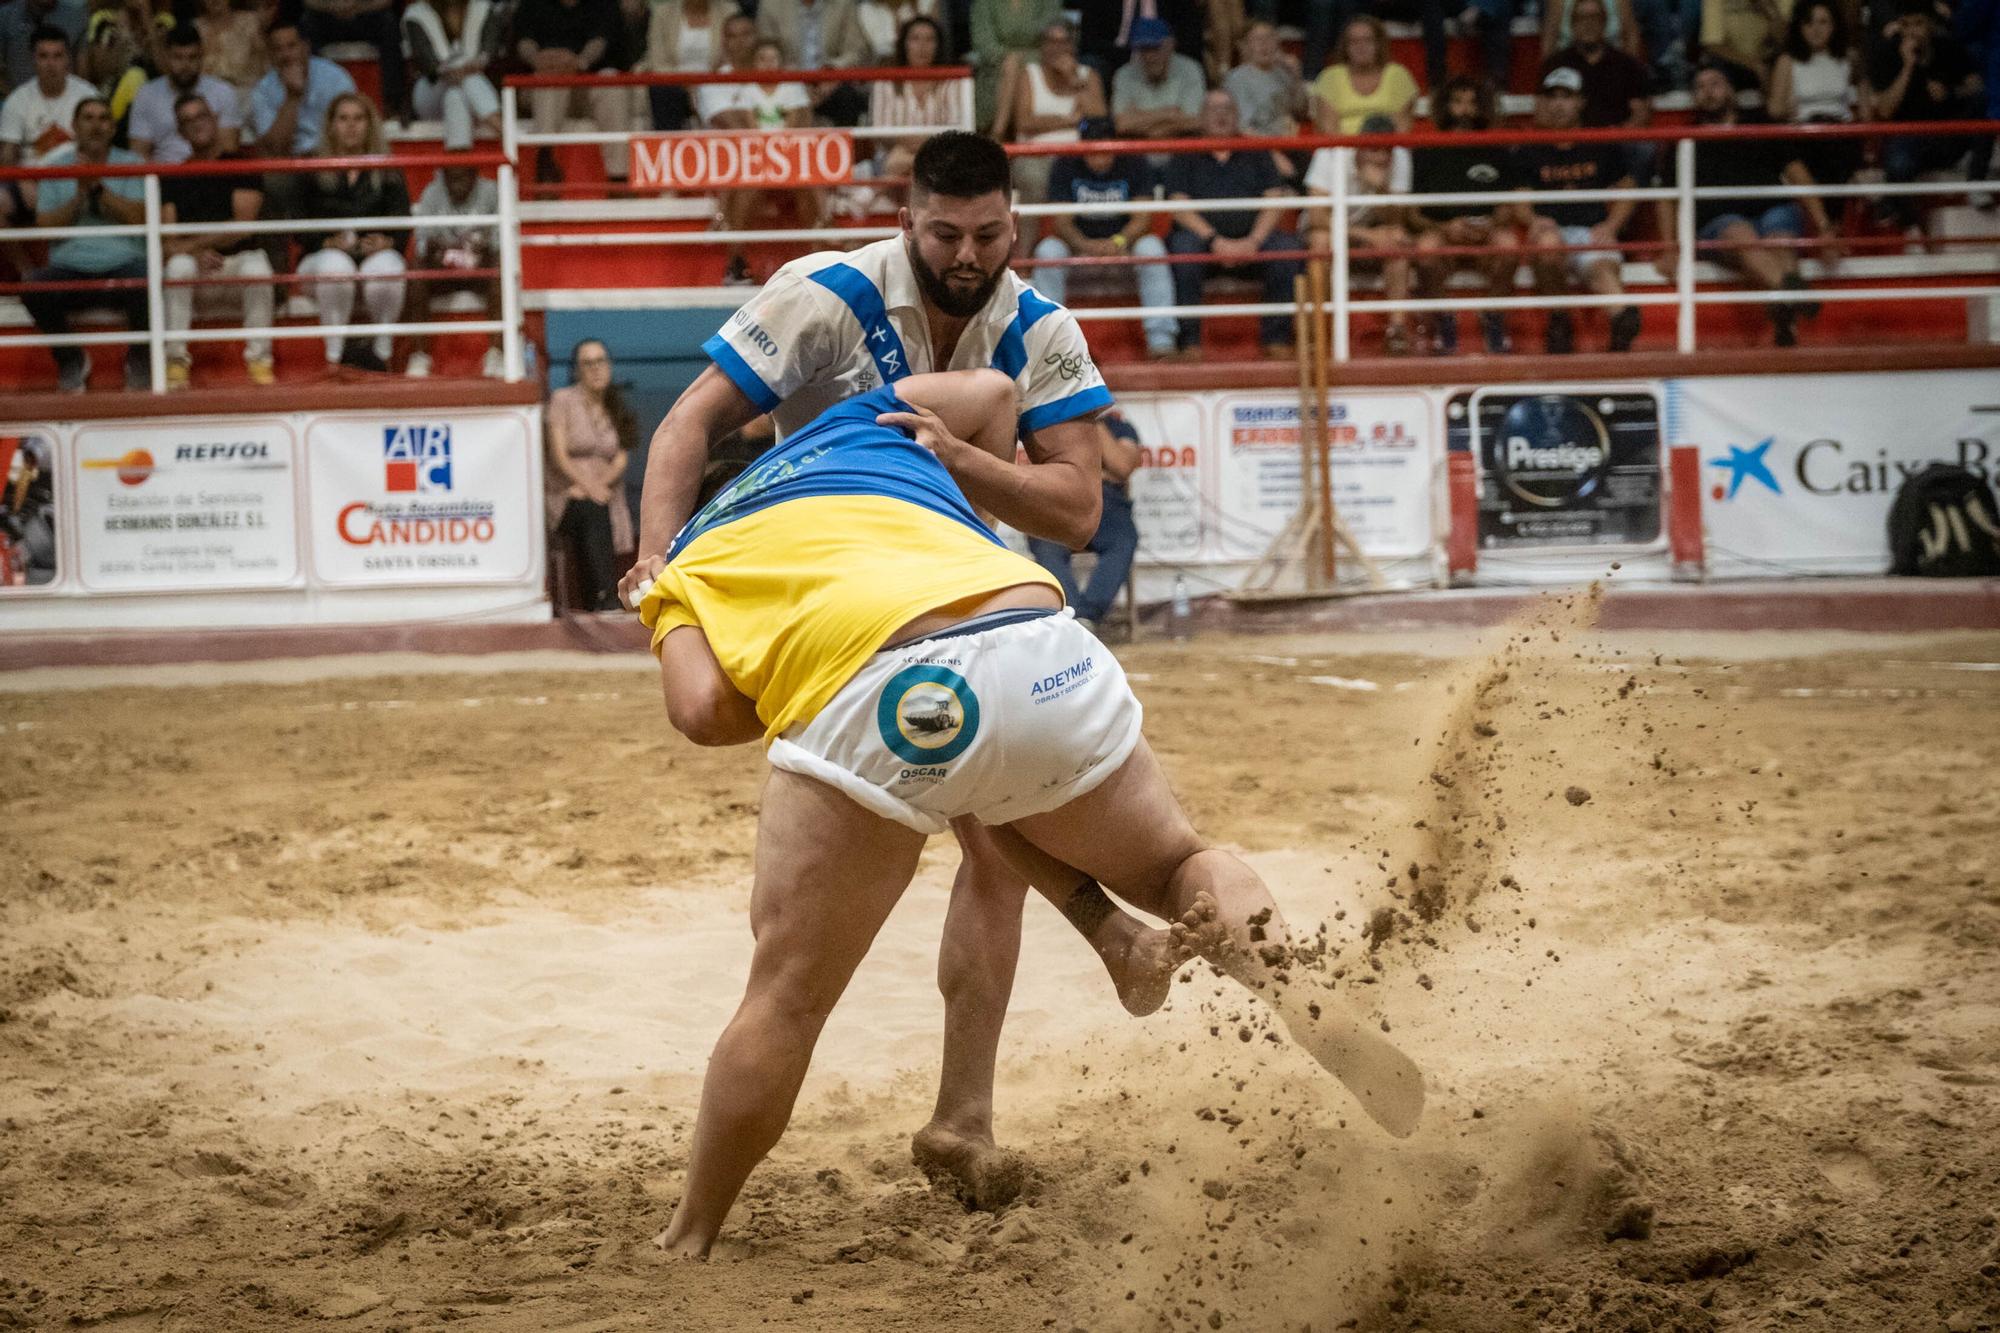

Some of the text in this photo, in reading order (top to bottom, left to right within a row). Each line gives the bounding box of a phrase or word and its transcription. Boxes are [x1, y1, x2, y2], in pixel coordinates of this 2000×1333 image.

[634, 133, 850, 187] MODESTO
[175, 442, 270, 460] REPSOL
[1507, 435, 1602, 474] Prestige
[336, 501, 495, 545] CANDIDO
[1030, 656, 1093, 697] ADEYMAR
[900, 767, 948, 779] OSCAR
